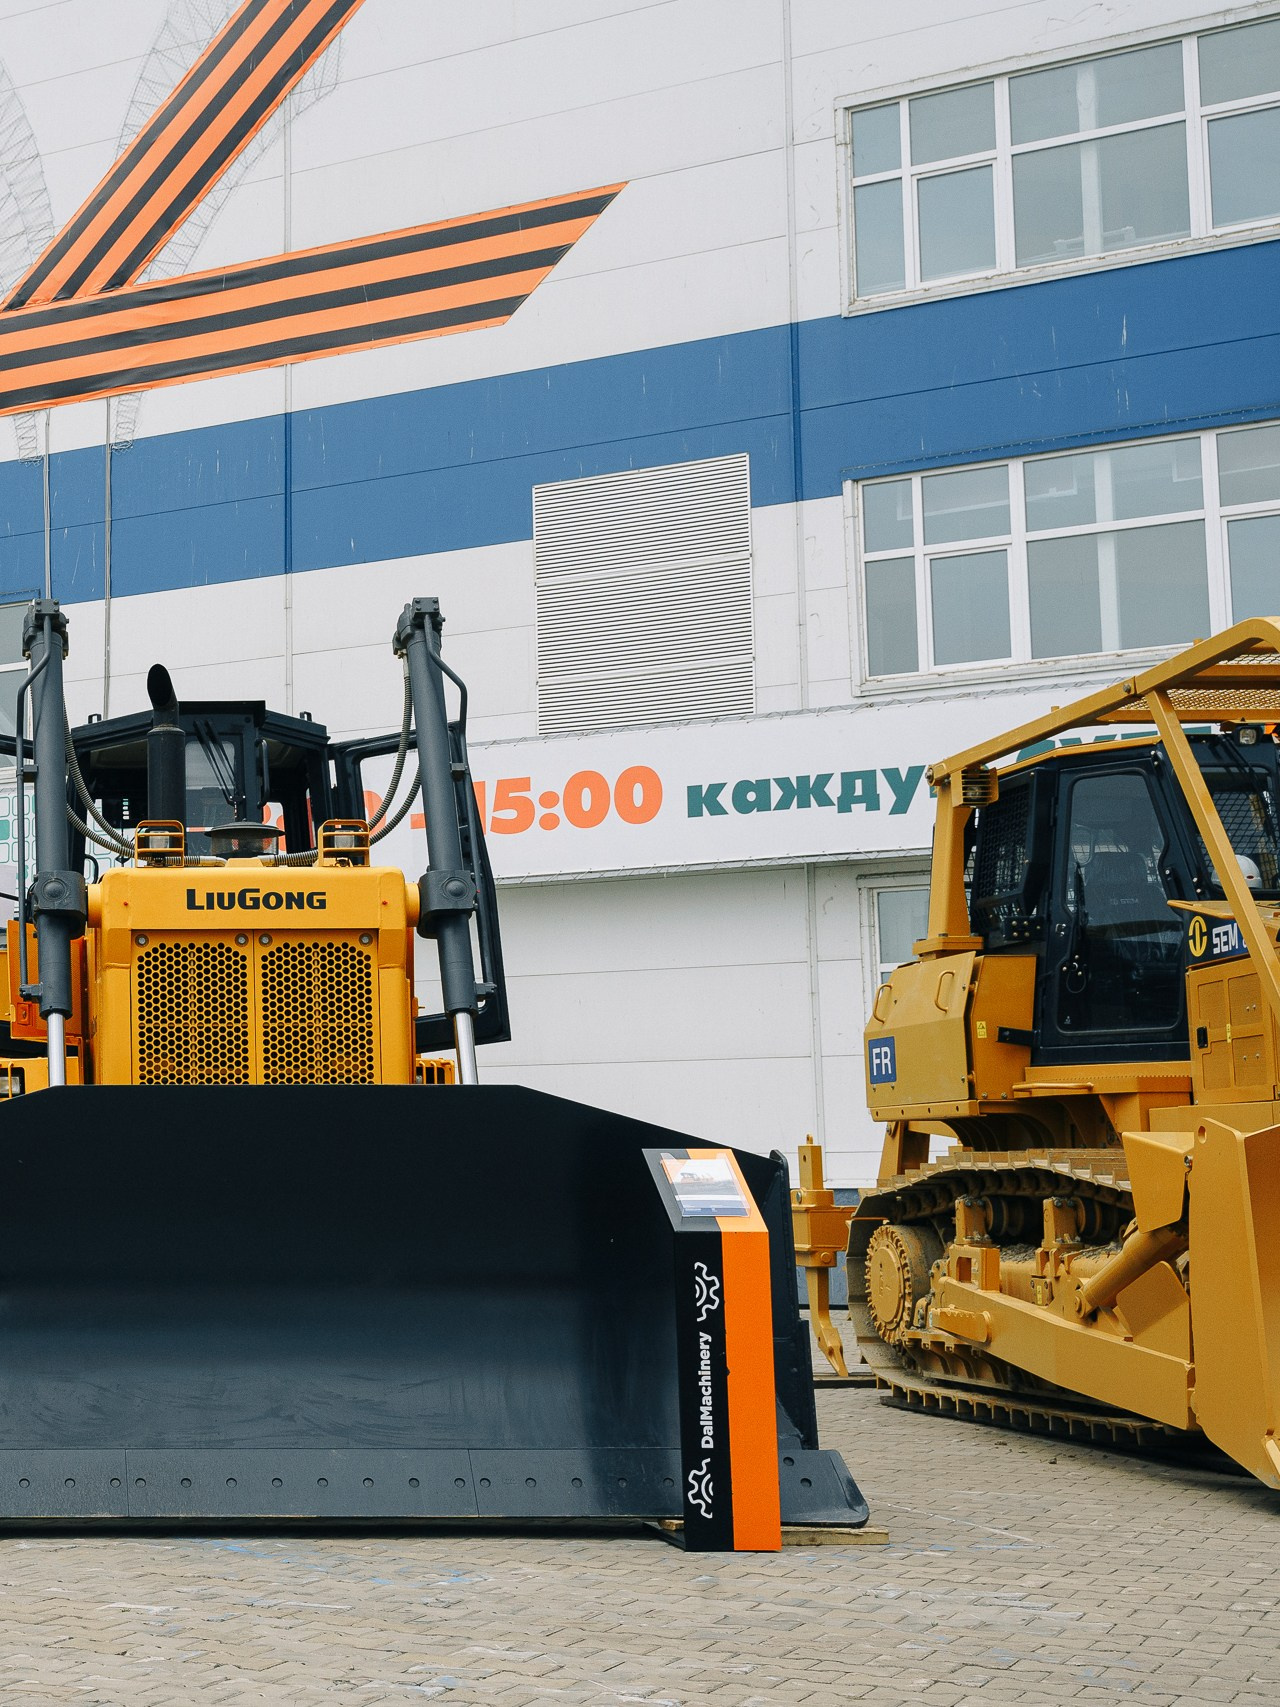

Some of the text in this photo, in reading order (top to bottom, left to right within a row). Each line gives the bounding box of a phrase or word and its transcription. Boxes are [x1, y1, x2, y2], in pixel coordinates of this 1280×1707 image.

[686, 765, 937, 818] кажду
[1212, 922, 1239, 955] SEM
[872, 1046, 892, 1076] FR
[698, 1331, 715, 1449] DalMachinery
